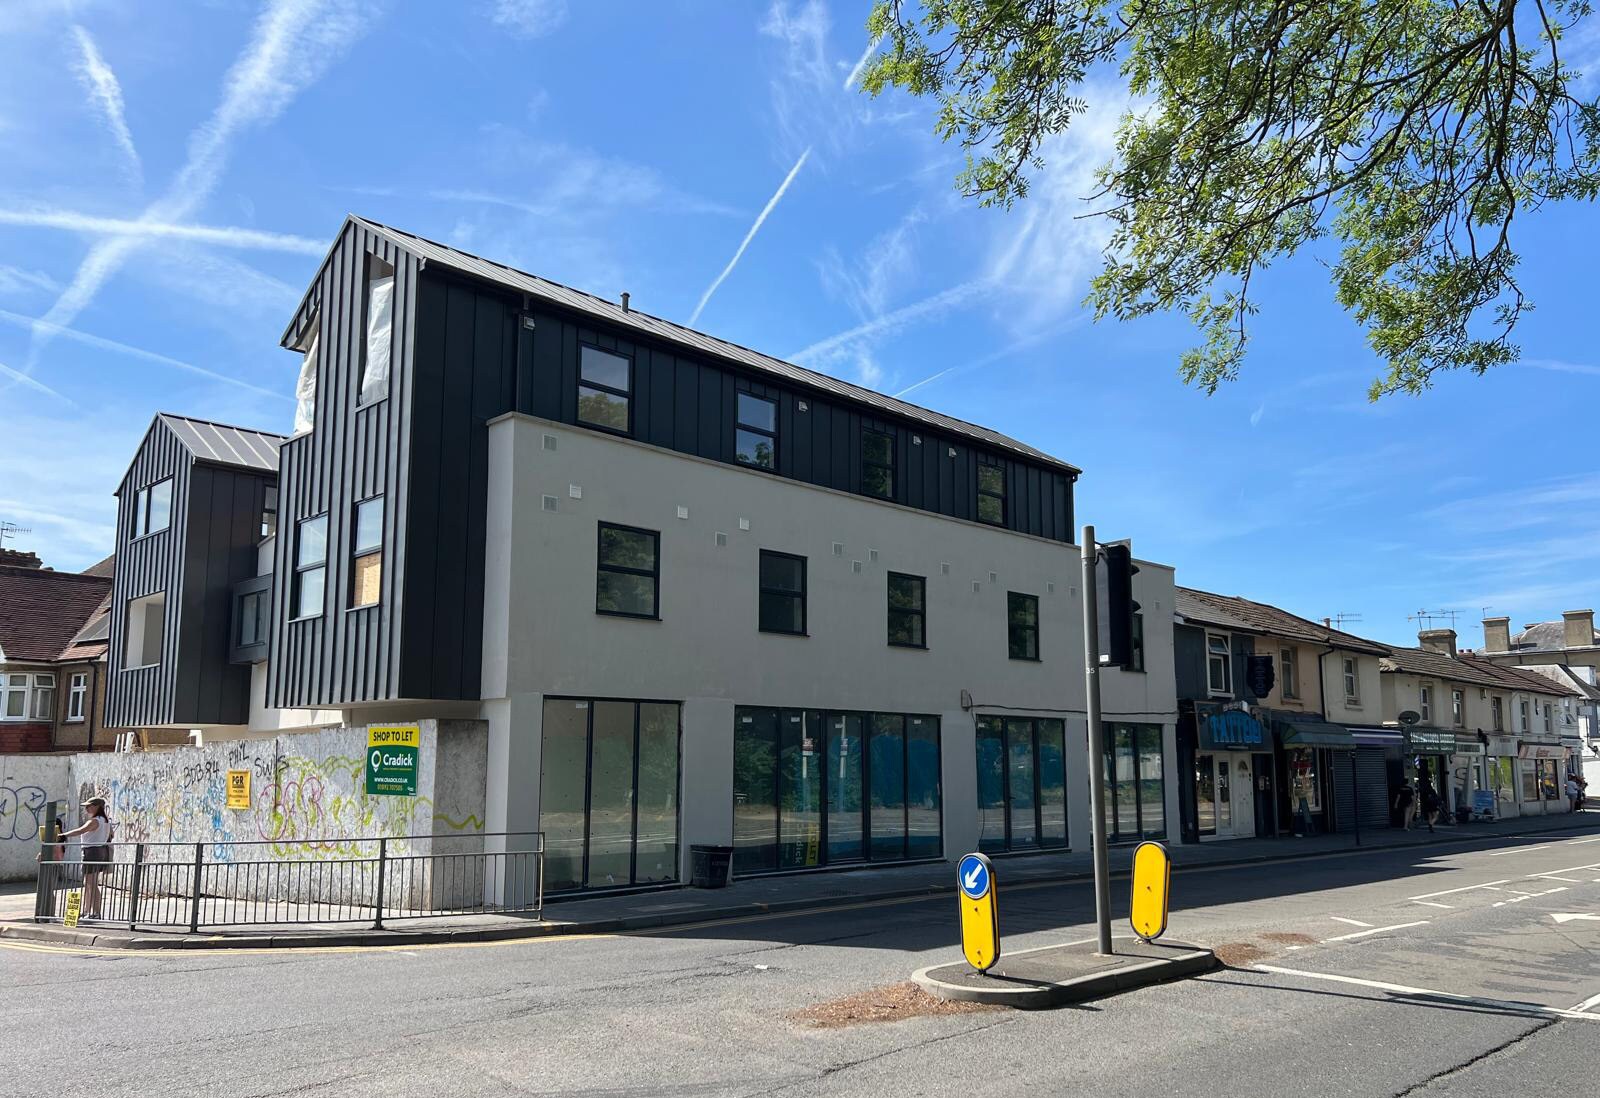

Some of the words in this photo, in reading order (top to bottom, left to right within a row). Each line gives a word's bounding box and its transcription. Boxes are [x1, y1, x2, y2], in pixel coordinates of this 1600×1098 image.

[1210, 714, 1263, 743] TATTOO
[373, 731, 390, 741] SHOP
[392, 731, 400, 741] TO
[402, 731, 413, 741] LET
[383, 753, 413, 766] Cradick
